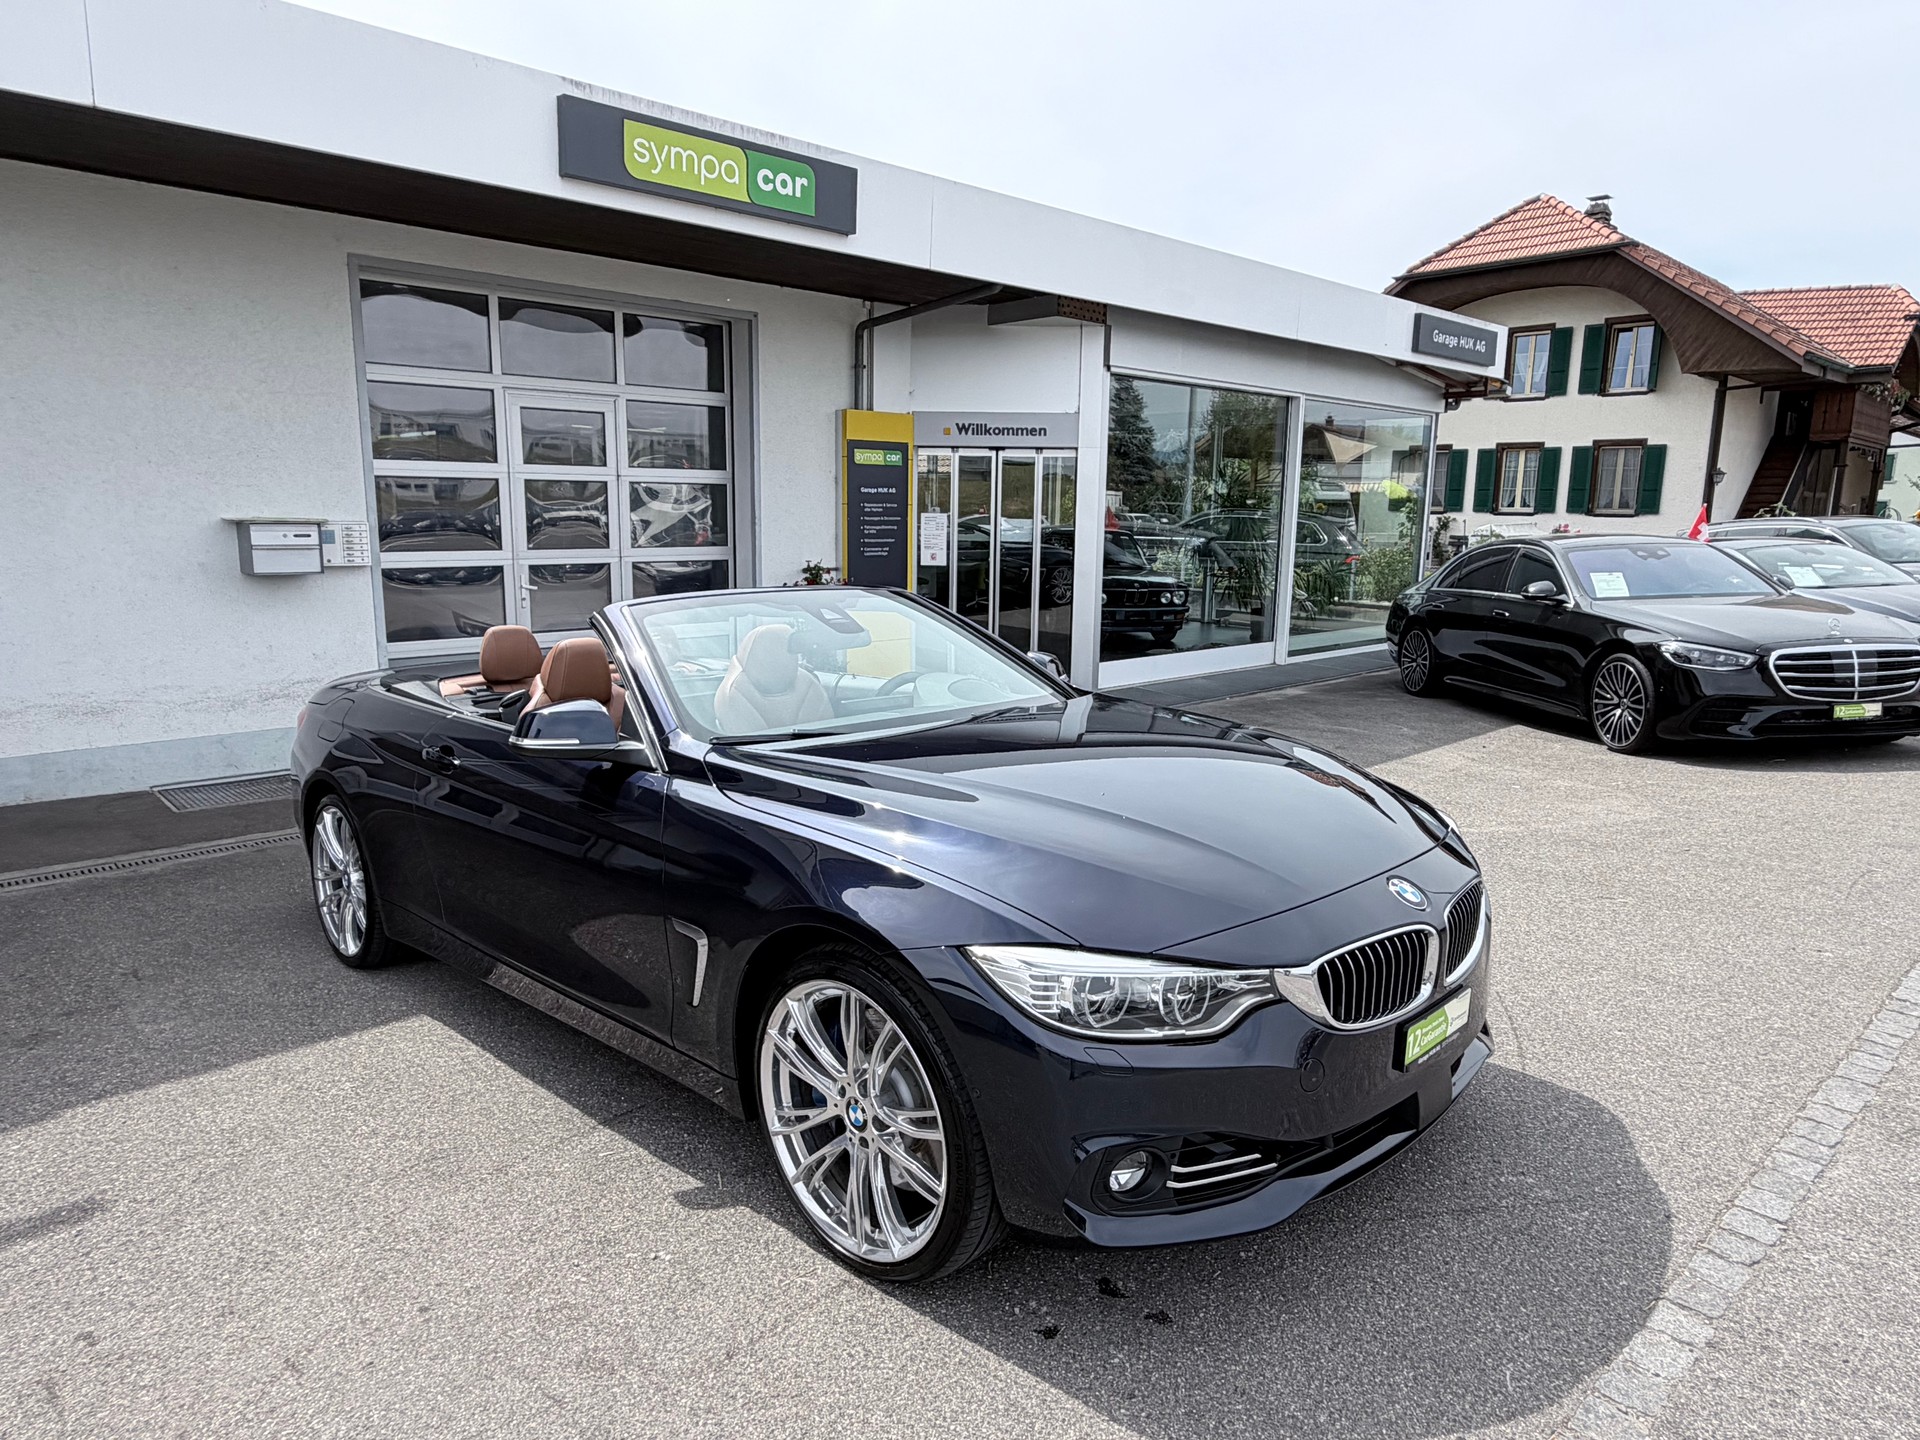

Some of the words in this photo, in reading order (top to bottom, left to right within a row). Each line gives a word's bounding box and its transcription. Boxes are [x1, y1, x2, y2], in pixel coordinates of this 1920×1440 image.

[633, 137, 739, 185] sympa
[757, 168, 809, 198] car
[1433, 329, 1459, 348] Garage
[1459, 335, 1475, 350] HUK
[1475, 340, 1486, 353] AG
[955, 422, 1047, 437] Willkommen
[855, 452, 882, 462] sympa
[886, 454, 901, 462] car
[1835, 706, 1845, 716] 12
[1408, 1029, 1422, 1058] 12
